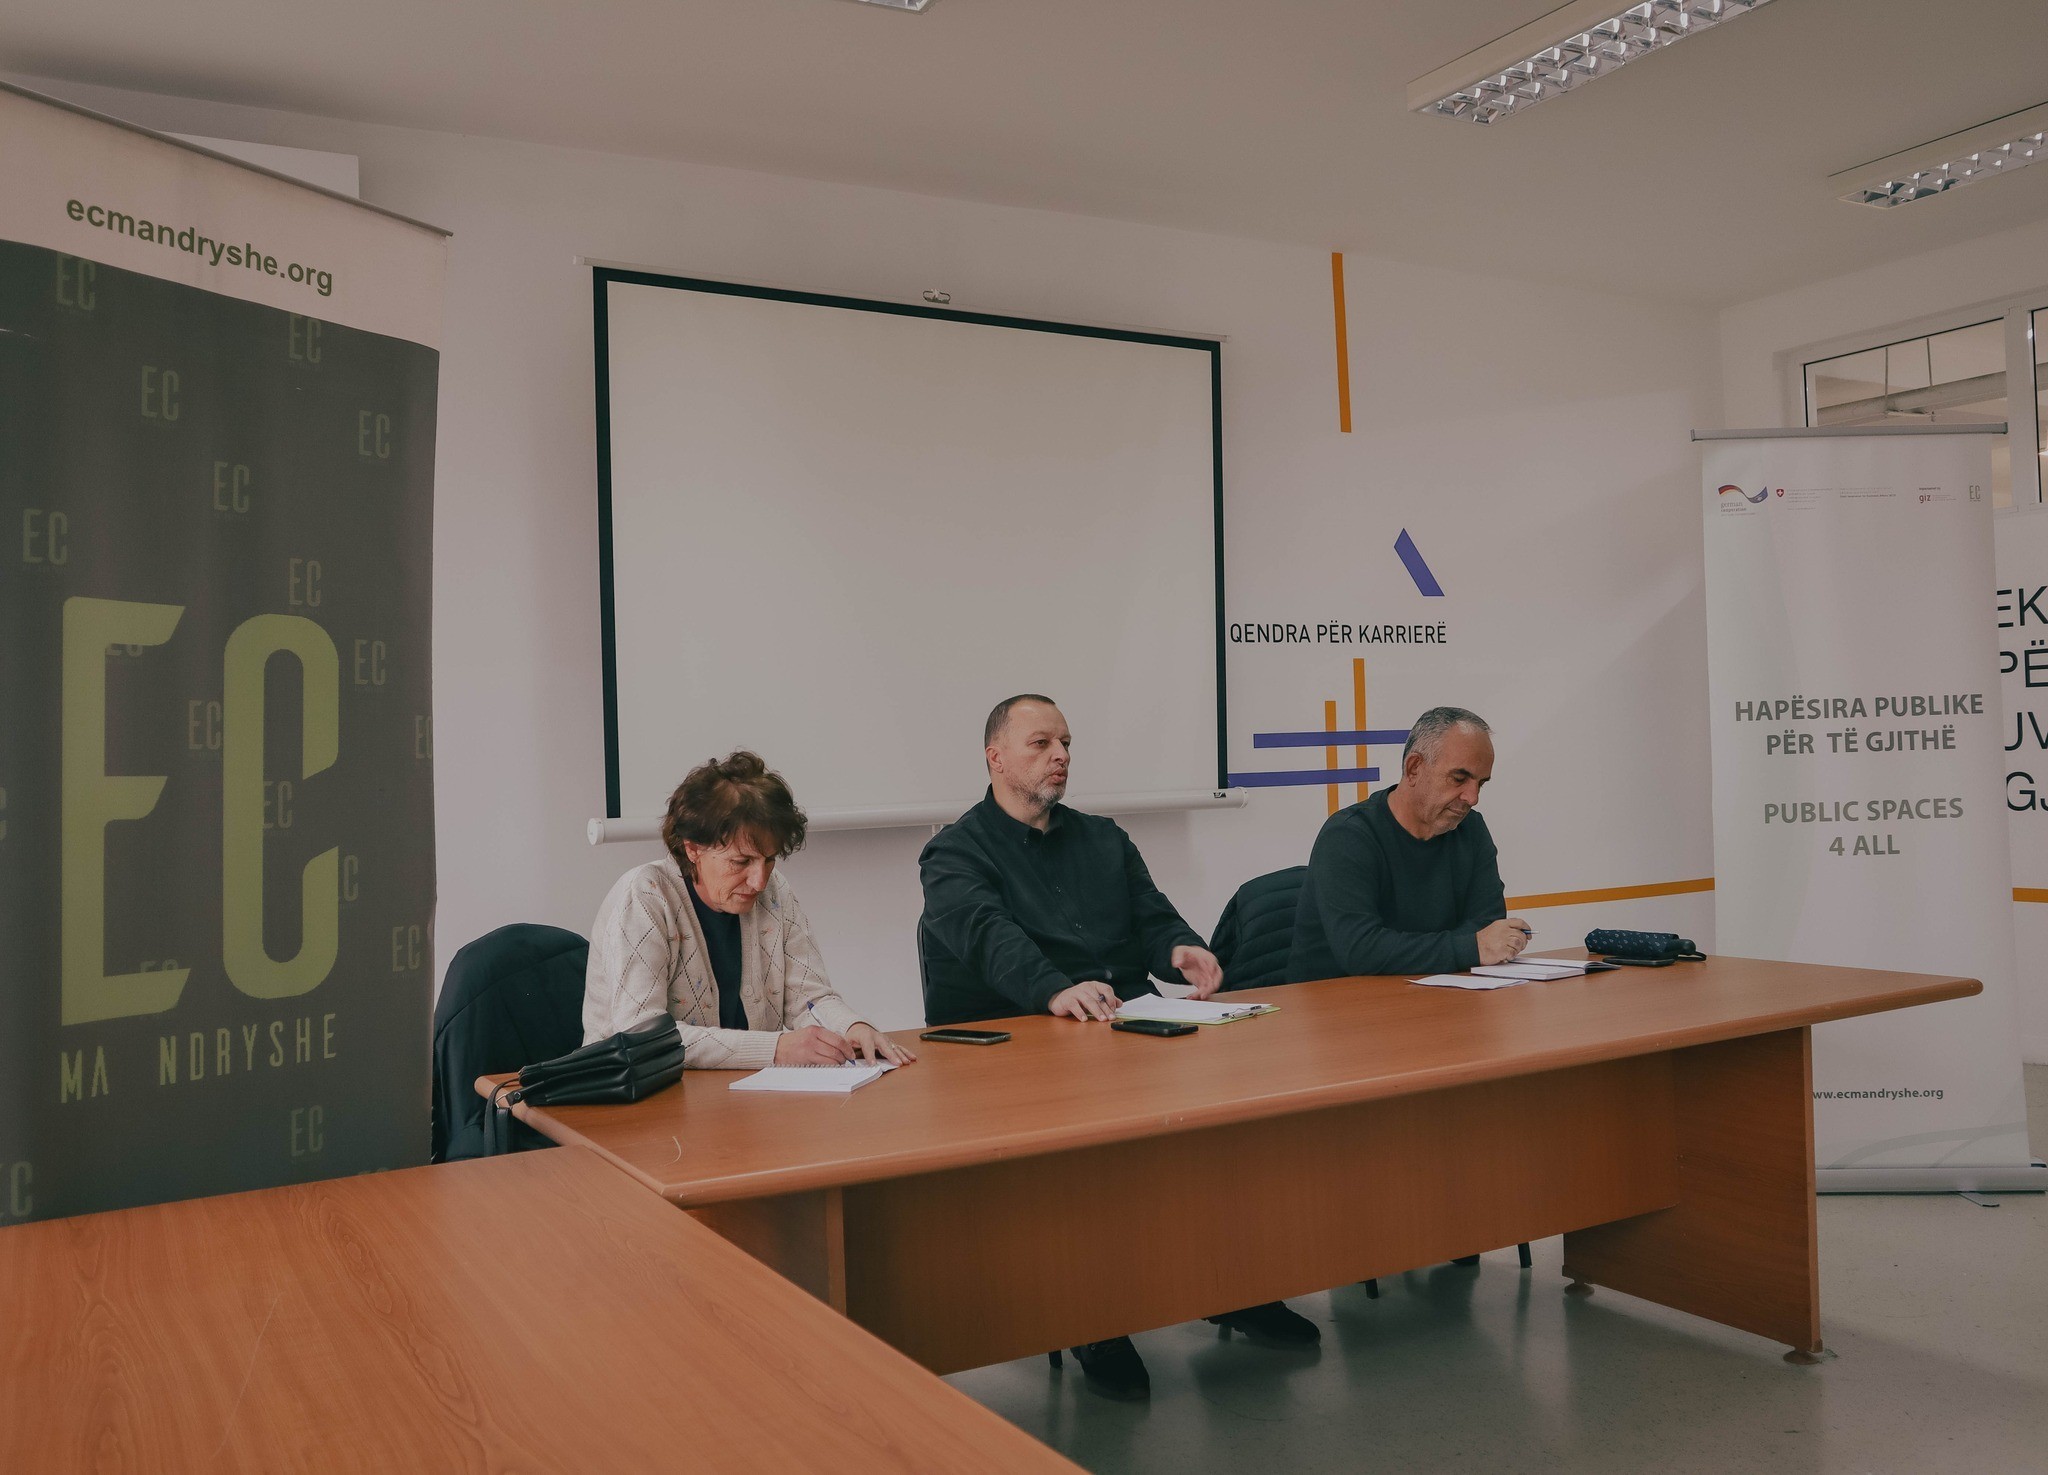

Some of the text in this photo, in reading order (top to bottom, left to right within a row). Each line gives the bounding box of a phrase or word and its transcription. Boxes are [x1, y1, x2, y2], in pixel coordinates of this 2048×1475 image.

[66, 199, 333, 296] ecmandryshe.org
[56, 252, 96, 311] EC
[289, 313, 322, 364] EC
[140, 365, 180, 422] EC
[358, 410, 391, 459] EC
[213, 461, 250, 514] EC
[1969, 485, 1981, 500] EC
[22, 508, 68, 566] EC
[288, 558, 322, 607] EC
[1230, 620, 1447, 643] QENDRA PËR KARRIERË
[354, 639, 386, 686] EC
[188, 700, 222, 751] EC
[1735, 694, 1984, 722] HAPËSIRA PUBLIKE
[1767, 724, 1956, 755] PËR TË GJITHË
[61, 595, 339, 1027] EC
[1764, 798, 1964, 824] PUBLIC SPACES
[1829, 834, 1900, 856] 4 ALL
[392, 924, 421, 973] EC
[60, 1013, 338, 1104] MA NDRYSHE
[290, 1104, 324, 1157] EC
